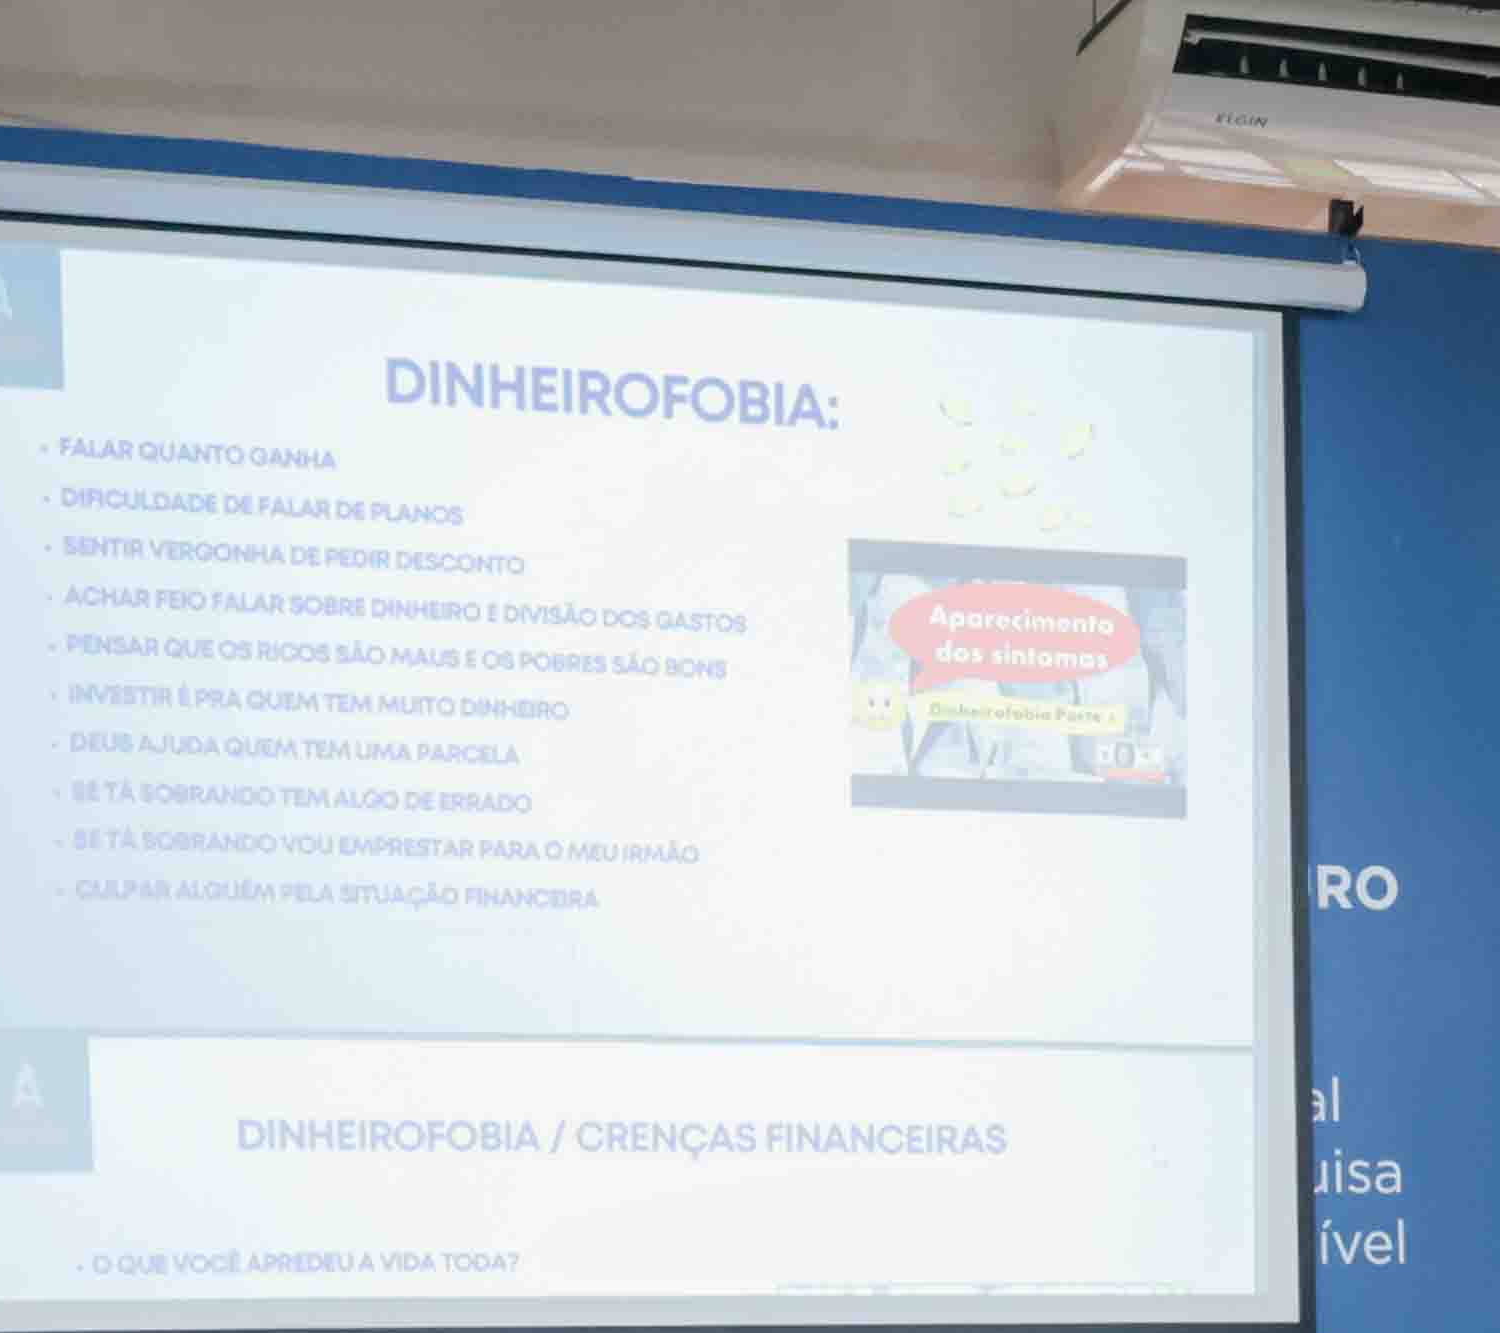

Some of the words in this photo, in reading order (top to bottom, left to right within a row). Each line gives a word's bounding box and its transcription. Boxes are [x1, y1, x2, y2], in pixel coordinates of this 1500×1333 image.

[385, 356, 841, 433] DINHEIROFOBIA:
[58, 437, 133, 462] FALAR
[138, 441, 246, 466] QUANTO
[250, 446, 337, 470] GANHA
[60, 488, 218, 516] DIFICULDADE
[225, 494, 255, 517] DE
[259, 496, 331, 521] FALAR
[336, 500, 365, 522] DE
[371, 501, 465, 526] PLANOS
[62, 536, 145, 561] SENTIR
[290, 544, 320, 567] DE
[325, 546, 391, 571] PEDIR
[396, 549, 525, 576] DESCONTO
[64, 585, 151, 610] ACHAR
[155, 589, 207, 612] FEIO
[211, 591, 285, 615] FALAR
[289, 594, 365, 619] SOBRE
[371, 597, 482, 623] DINHEIRO
[503, 599, 597, 627] DIVISÃO
[603, 606, 651, 630] DOS
[656, 608, 747, 634] GASTOS
[929, 604, 1115, 637] Aparecimento
[935, 639, 983, 664] dos
[991, 642, 1109, 670] sintomas
[1306, 864, 1399, 911] RO
[235, 1116, 540, 1158] DINHEIROFOBIA
[575, 1118, 757, 1163] CRENÇAS
[764, 1118, 1009, 1158] FINANCEIRAS
[91, 1253, 112, 1277] O
[115, 1254, 170, 1277] QUE
[174, 1247, 242, 1275] VOCÊ
[246, 1252, 353, 1275] APREDEU
[360, 1252, 376, 1274] A
[380, 1251, 438, 1273] VIDA
[442, 1250, 520, 1273] TODA?
